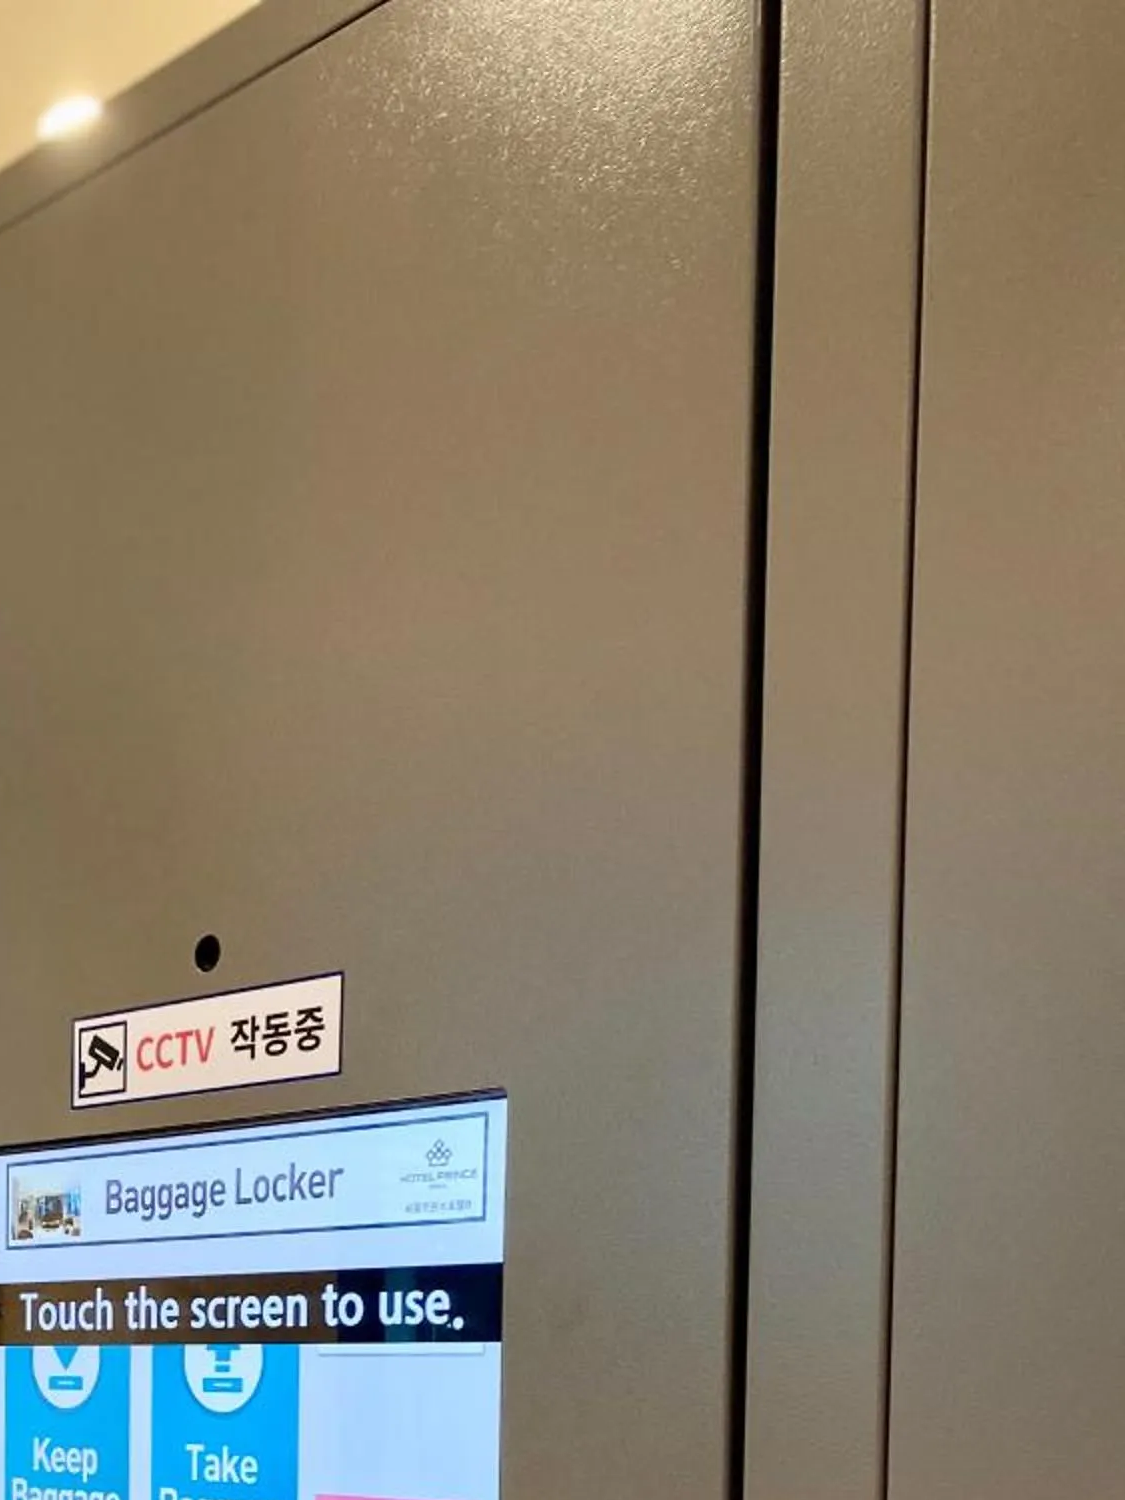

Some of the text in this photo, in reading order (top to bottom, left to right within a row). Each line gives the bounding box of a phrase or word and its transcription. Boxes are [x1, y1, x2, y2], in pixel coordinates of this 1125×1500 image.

[135, 1005, 325, 1072] CCTV 작동중
[105, 1162, 345, 1221] Baggage Locker
[20, 1284, 466, 1332] Touch the screen to use.
[32, 1437, 99, 1483] Keep
[185, 1443, 258, 1484] Take
